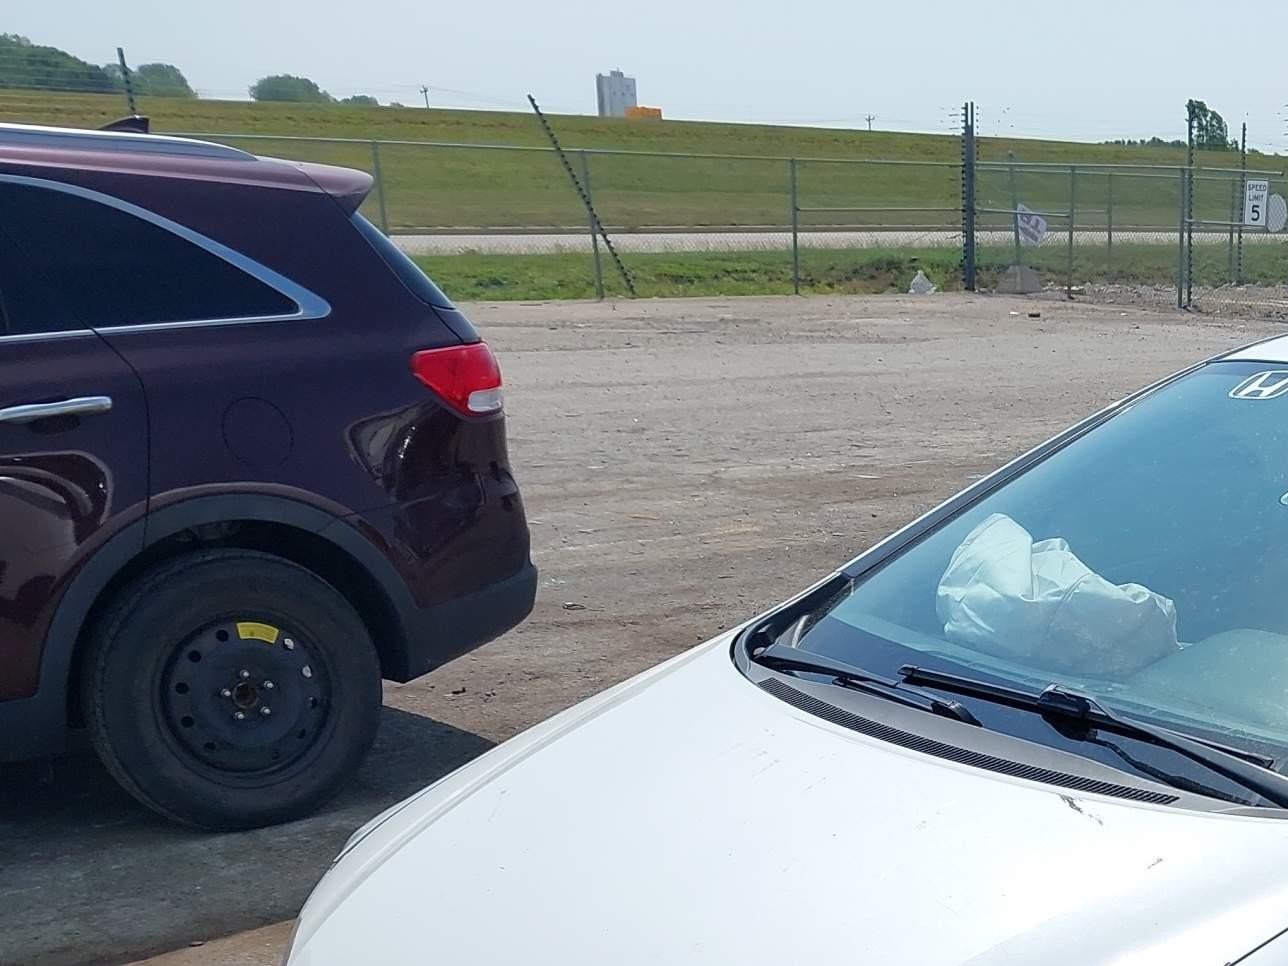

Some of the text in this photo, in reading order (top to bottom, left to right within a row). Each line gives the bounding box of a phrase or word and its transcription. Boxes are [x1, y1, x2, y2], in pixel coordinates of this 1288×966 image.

[1248, 183, 1267, 192] SPEED
[1248, 193, 1264, 202] LIMIT
[1250, 204, 1260, 222] 5
